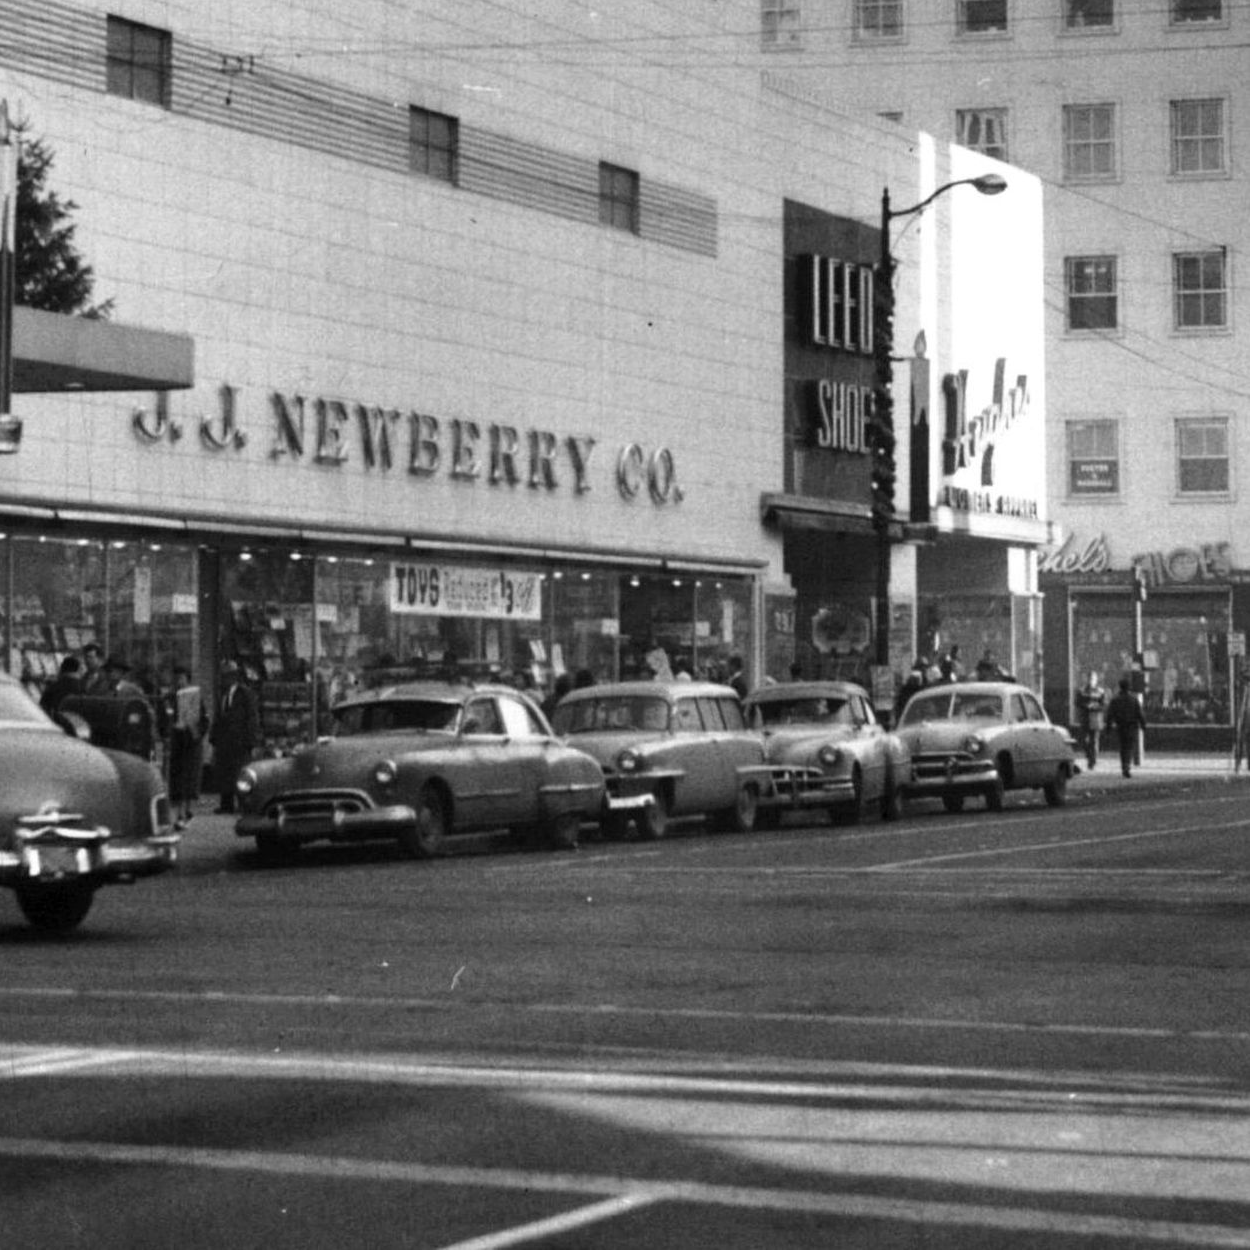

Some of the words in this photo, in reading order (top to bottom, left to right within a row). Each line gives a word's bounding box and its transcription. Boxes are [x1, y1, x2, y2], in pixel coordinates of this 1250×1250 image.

[268, 391, 596, 496] NEWBERRY
[616, 442, 684, 506] CO.
[395, 567, 440, 607] TOYS
